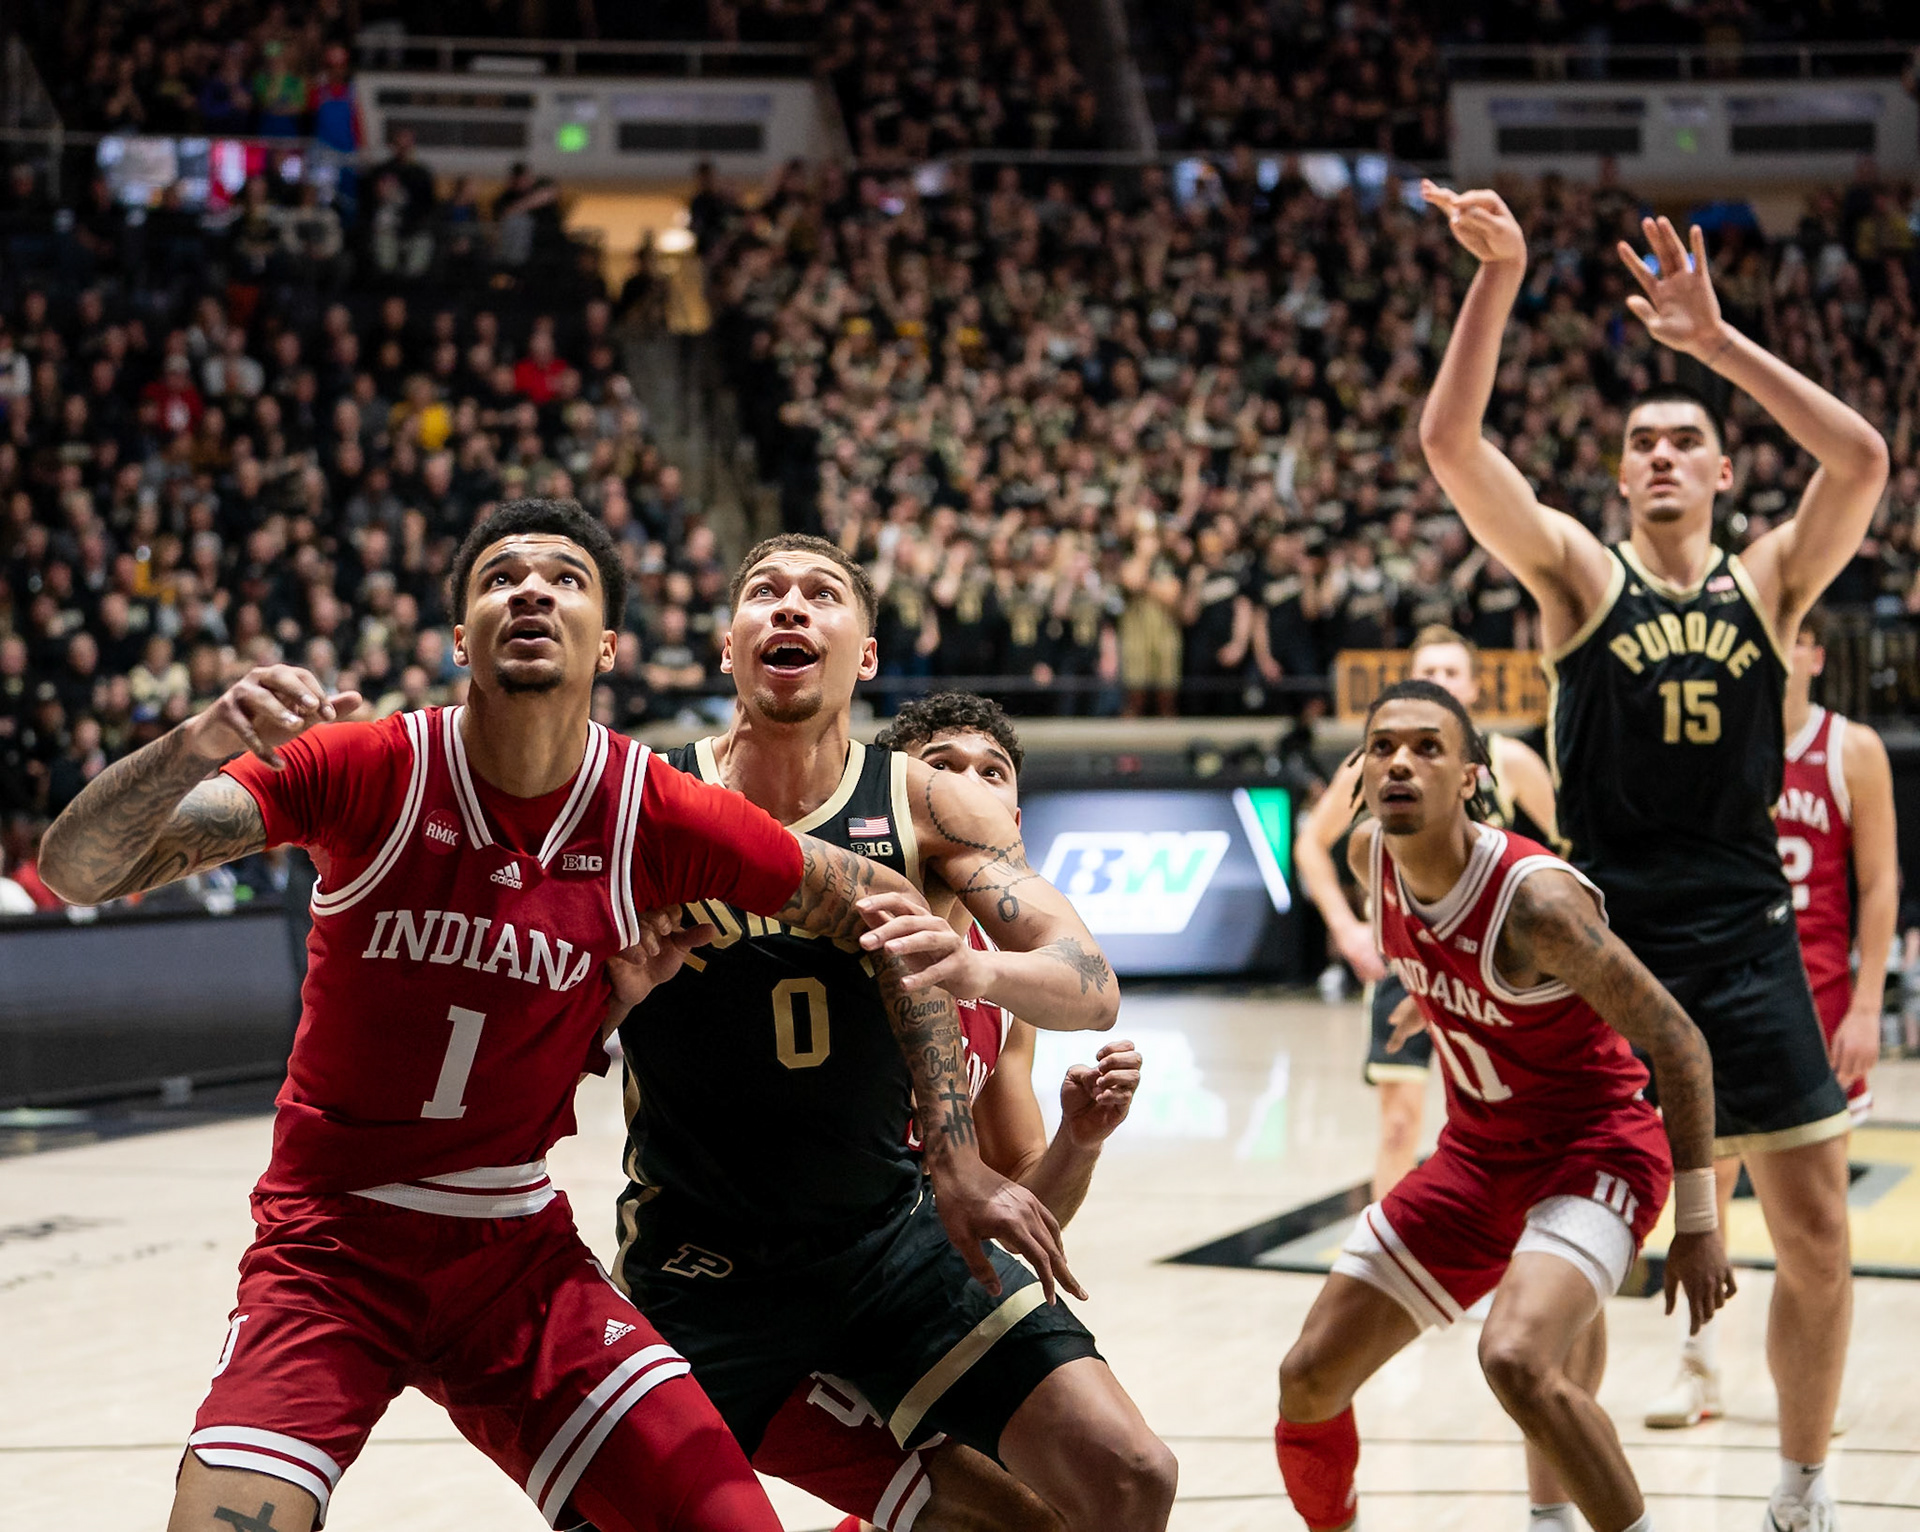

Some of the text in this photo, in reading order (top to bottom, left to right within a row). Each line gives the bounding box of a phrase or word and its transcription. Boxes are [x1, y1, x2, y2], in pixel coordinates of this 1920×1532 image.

[1609, 611, 1762, 679] PURDUE
[1658, 679, 1722, 745] 15
[425, 821, 459, 847] RMK
[489, 872, 523, 890] adidas
[361, 909, 592, 992] INDIANA
[771, 976, 831, 1070] 0
[894, 996, 947, 1028] Reason
[420, 1004, 487, 1120] 1
[923, 1045, 960, 1081] Bad
[604, 1324, 636, 1346] adidas
